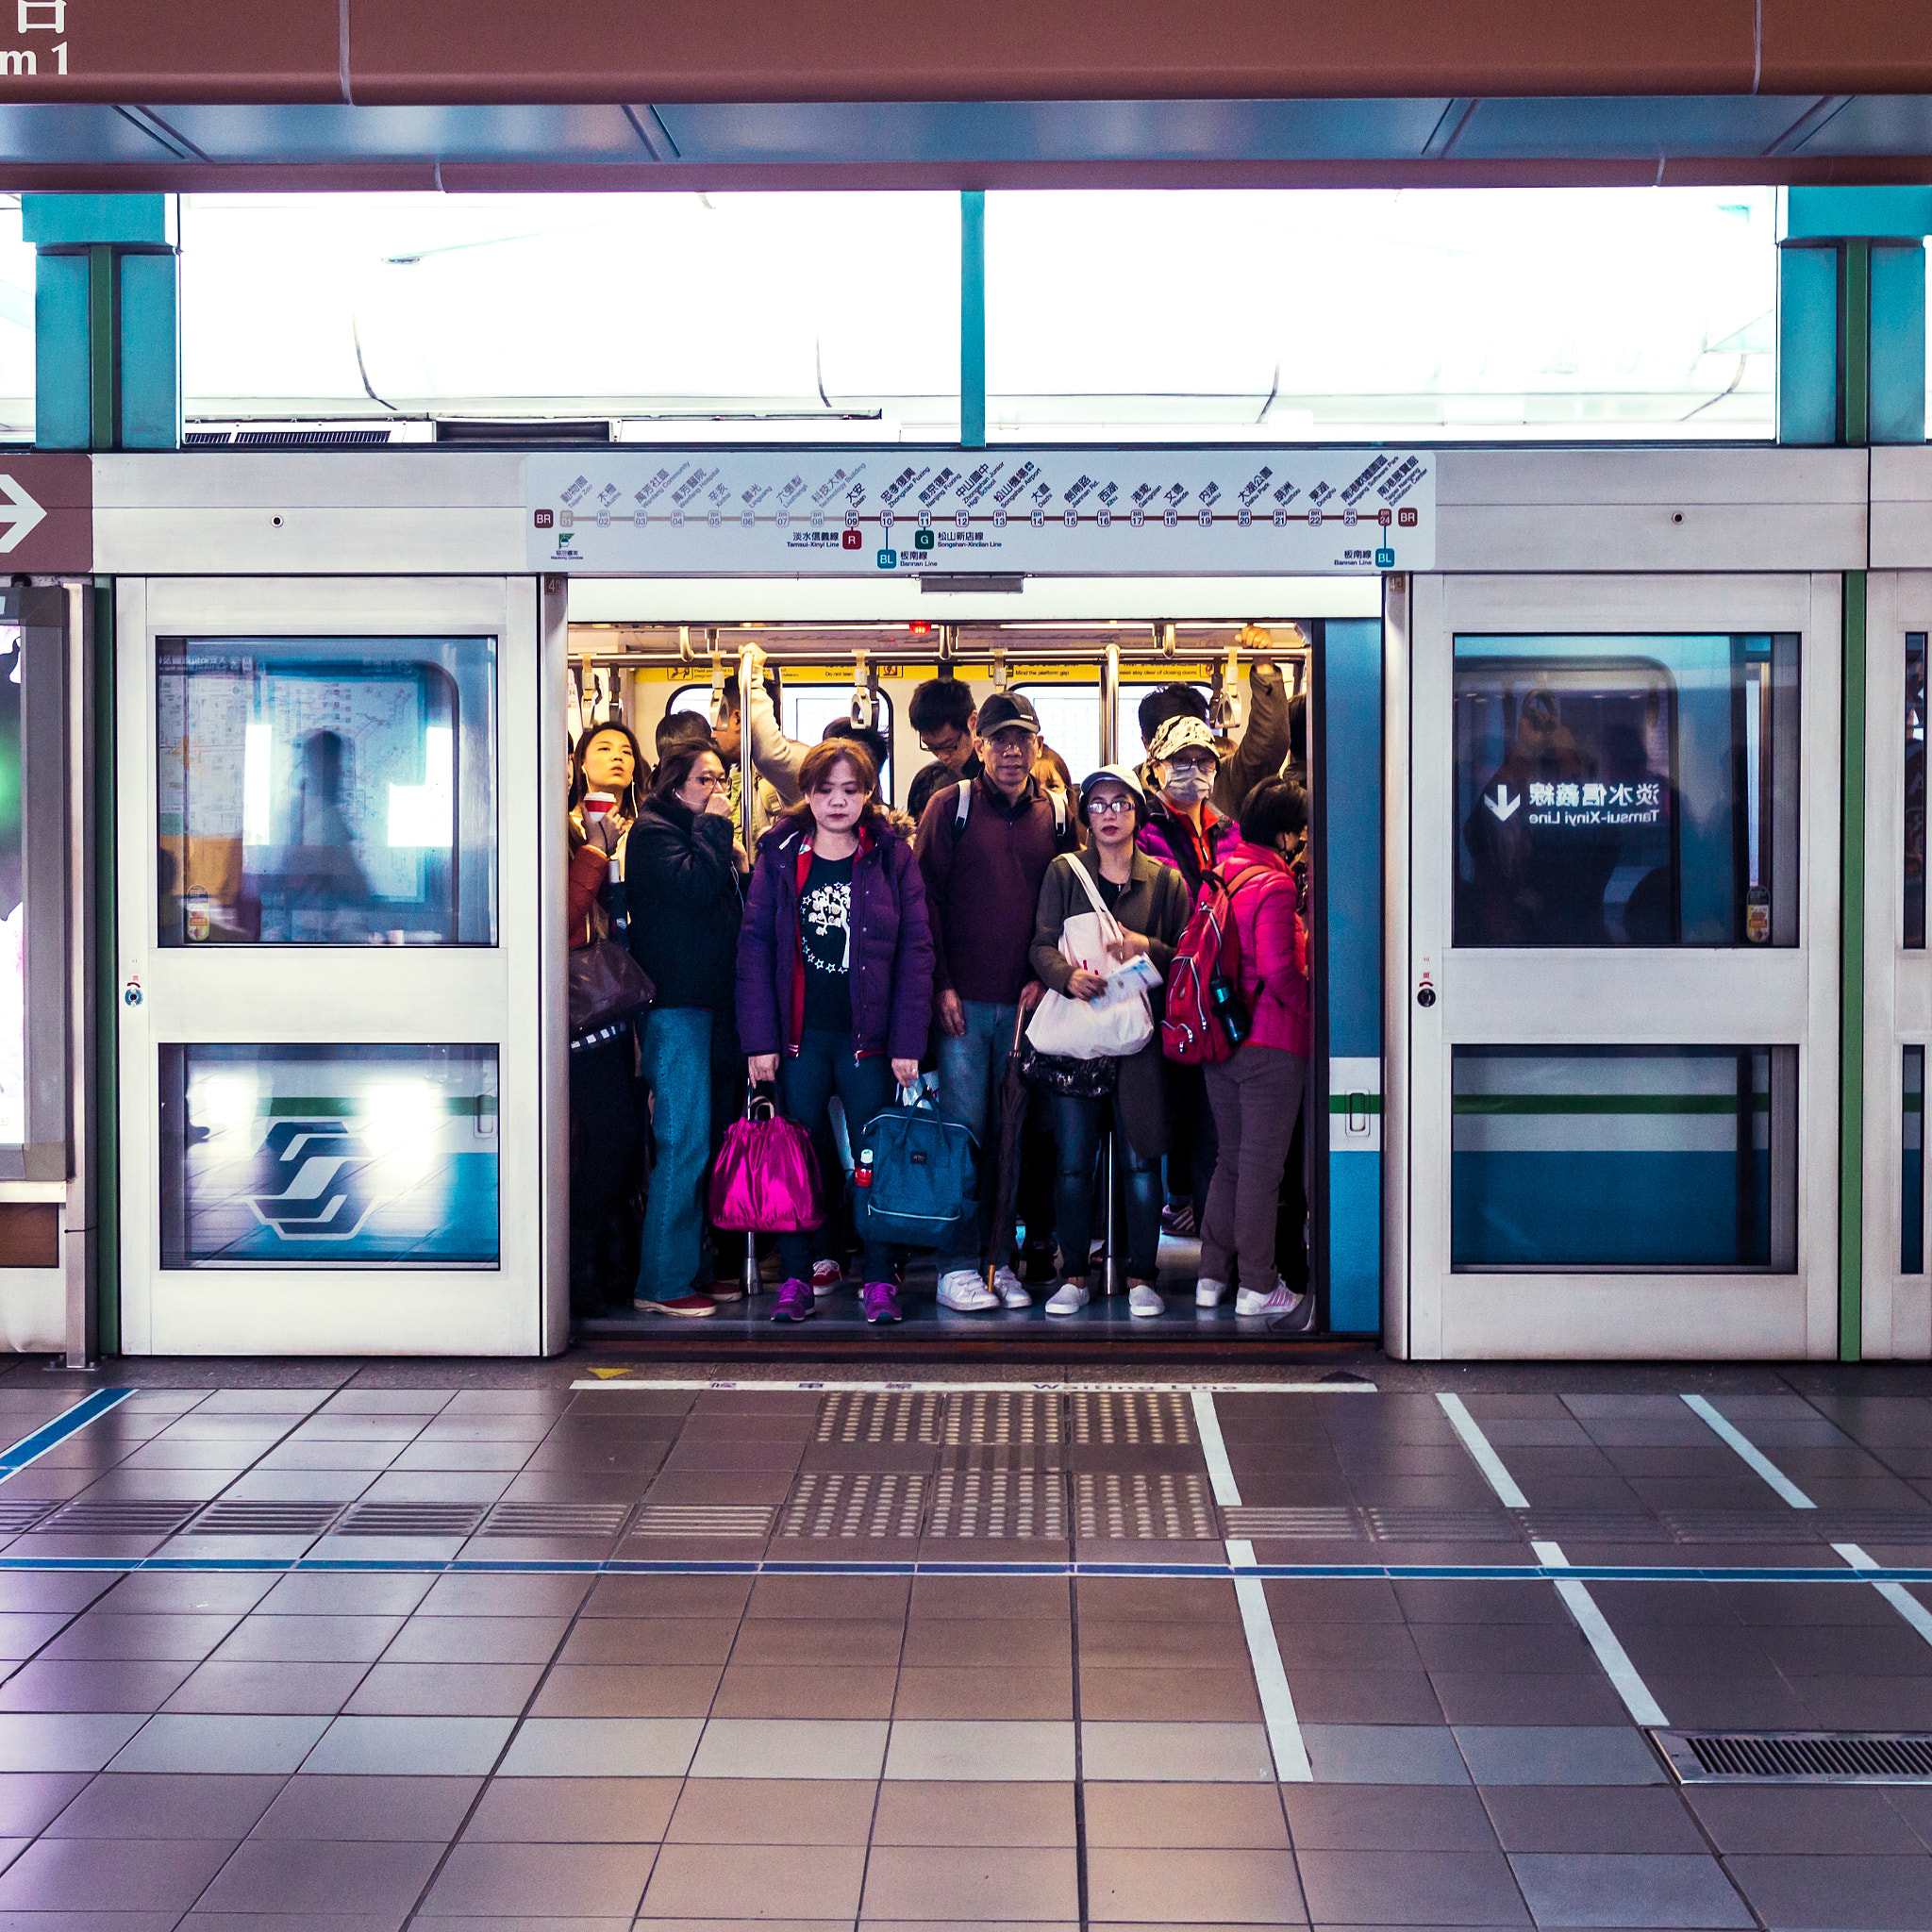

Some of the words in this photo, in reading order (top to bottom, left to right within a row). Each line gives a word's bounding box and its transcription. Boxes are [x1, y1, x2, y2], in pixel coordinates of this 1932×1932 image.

[51, 42, 67, 75] 1
[662, 461, 691, 488] Community
[699, 468, 720, 488] Hospital
[819, 482, 847, 508] Technology
[845, 462, 867, 483] Building
[880, 467, 916, 503] 忠孝復興
[918, 467, 954, 503] 南京復興
[956, 463, 990, 497] 中山國中
[962, 476, 991, 504] Zhongshan
[989, 461, 1005, 478] Junior
[1238, 466, 1273, 503] 大湖公園
[560, 475, 588, 503] 動物園
[582, 484, 592, 495] Zoo
[597, 483, 616, 503] 木柵
[634, 468, 669, 504] 萬芳社區
[671, 468, 707, 504] 萬芳醫院
[708, 483, 728, 502] 辛亥
[811, 468, 846, 503] 科技大樓
[845, 483, 865, 503] 大安
[888, 483, 914, 508] Zhongxiao
[912, 466, 931, 484] Fuxing
[925, 488, 946, 508] Nanjing
[943, 473, 962, 491] Fuxing
[967, 494, 980, 508] High
[979, 479, 996, 496] School
[993, 468, 1029, 503] 松山機場
[1001, 484, 1025, 508] Songshan
[1024, 468, 1042, 486] Airport
[1031, 482, 1051, 503] 大直
[1097, 481, 1119, 503] 西湖
[1164, 482, 1184, 503] 文德
[1257, 482, 1271, 495] Park
[604, 491, 622, 508] Muzha
[852, 494, 867, 508] Daan
[1038, 493, 1053, 508] Dazhi
[537, 514, 551, 524] BR
[1401, 513, 1415, 523] BR
[793, 532, 839, 541] 淡水信義線
[848, 536, 856, 544] R
[921, 536, 928, 544] G
[938, 532, 983, 541] 松山新店線
[880, 555, 893, 564] BL
[900, 551, 927, 559] 板南線
[1344, 550, 1372, 558] 板南線
[1378, 554, 1391, 562] BL
